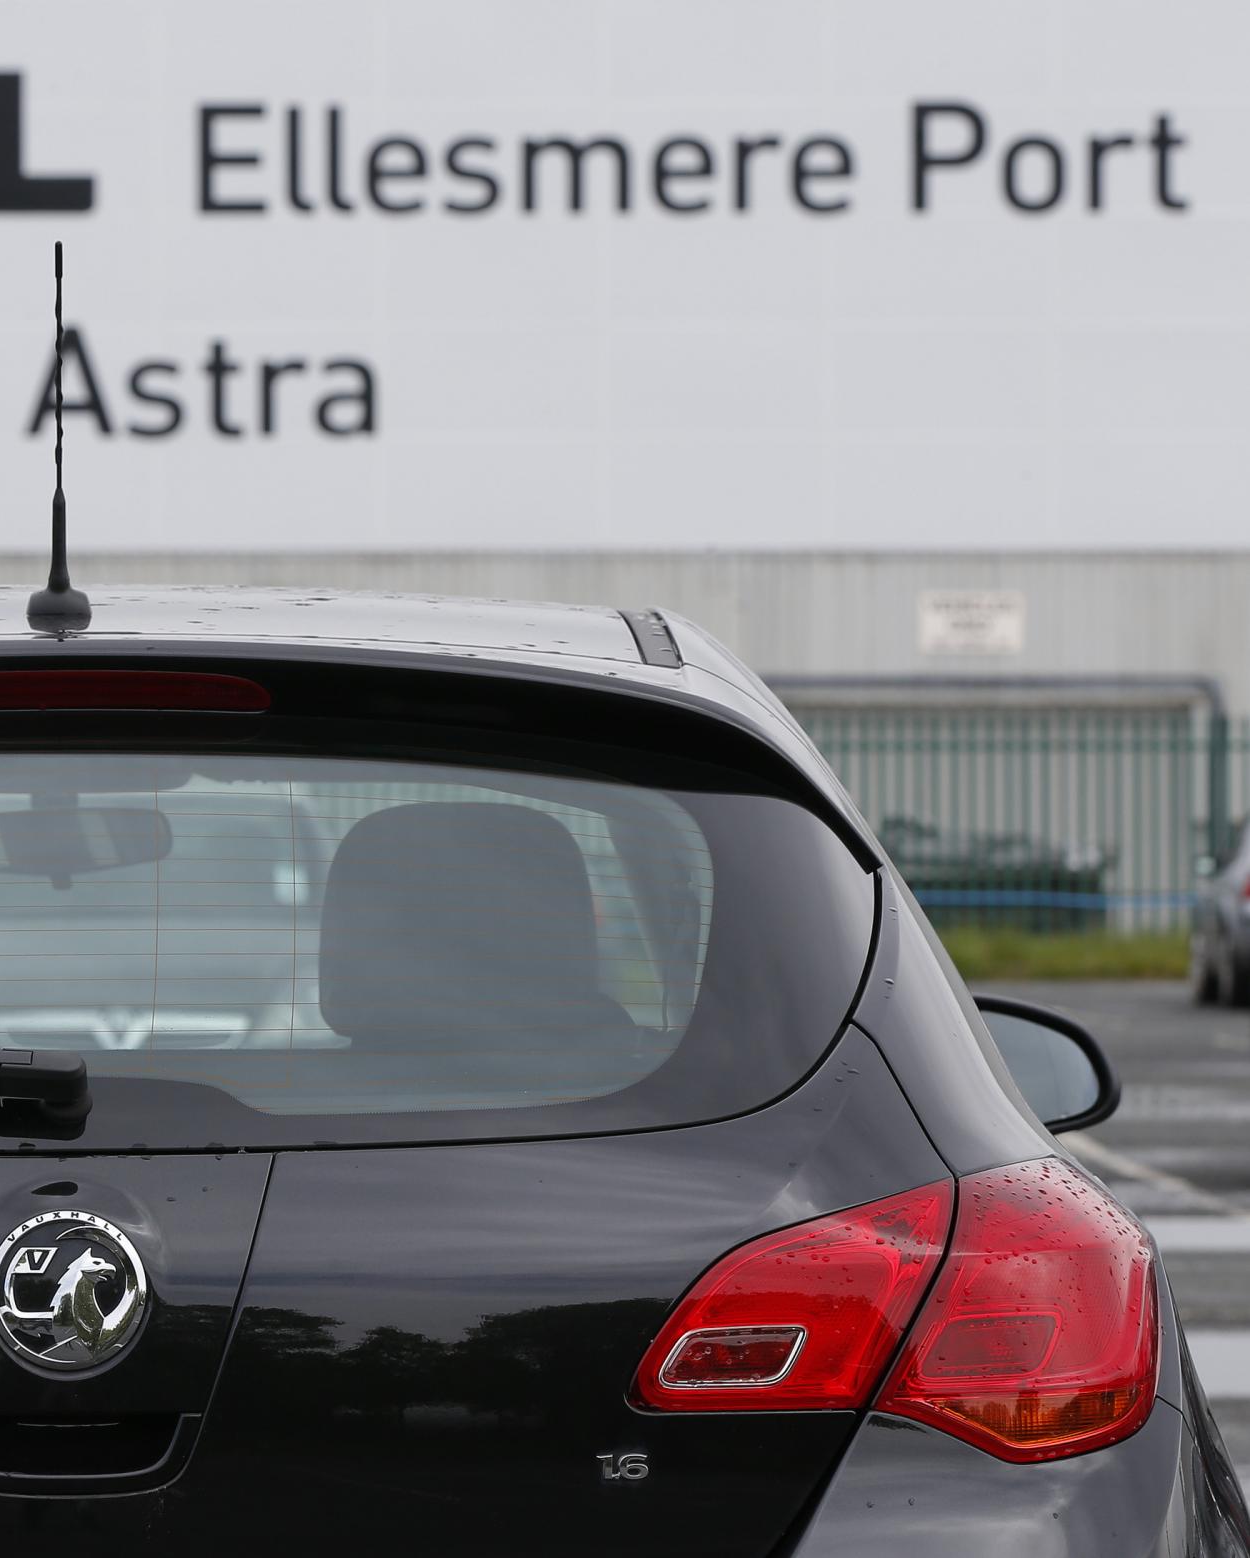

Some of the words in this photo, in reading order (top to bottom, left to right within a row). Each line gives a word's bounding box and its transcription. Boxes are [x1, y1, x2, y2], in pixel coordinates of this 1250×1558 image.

[197, 103, 855, 215] Ellesmere
[911, 101, 1188, 215] Port
[27, 326, 377, 439] Astra
[7, 1211, 122, 1242] VAUXHALL
[596, 1453, 649, 1479] 1.6
